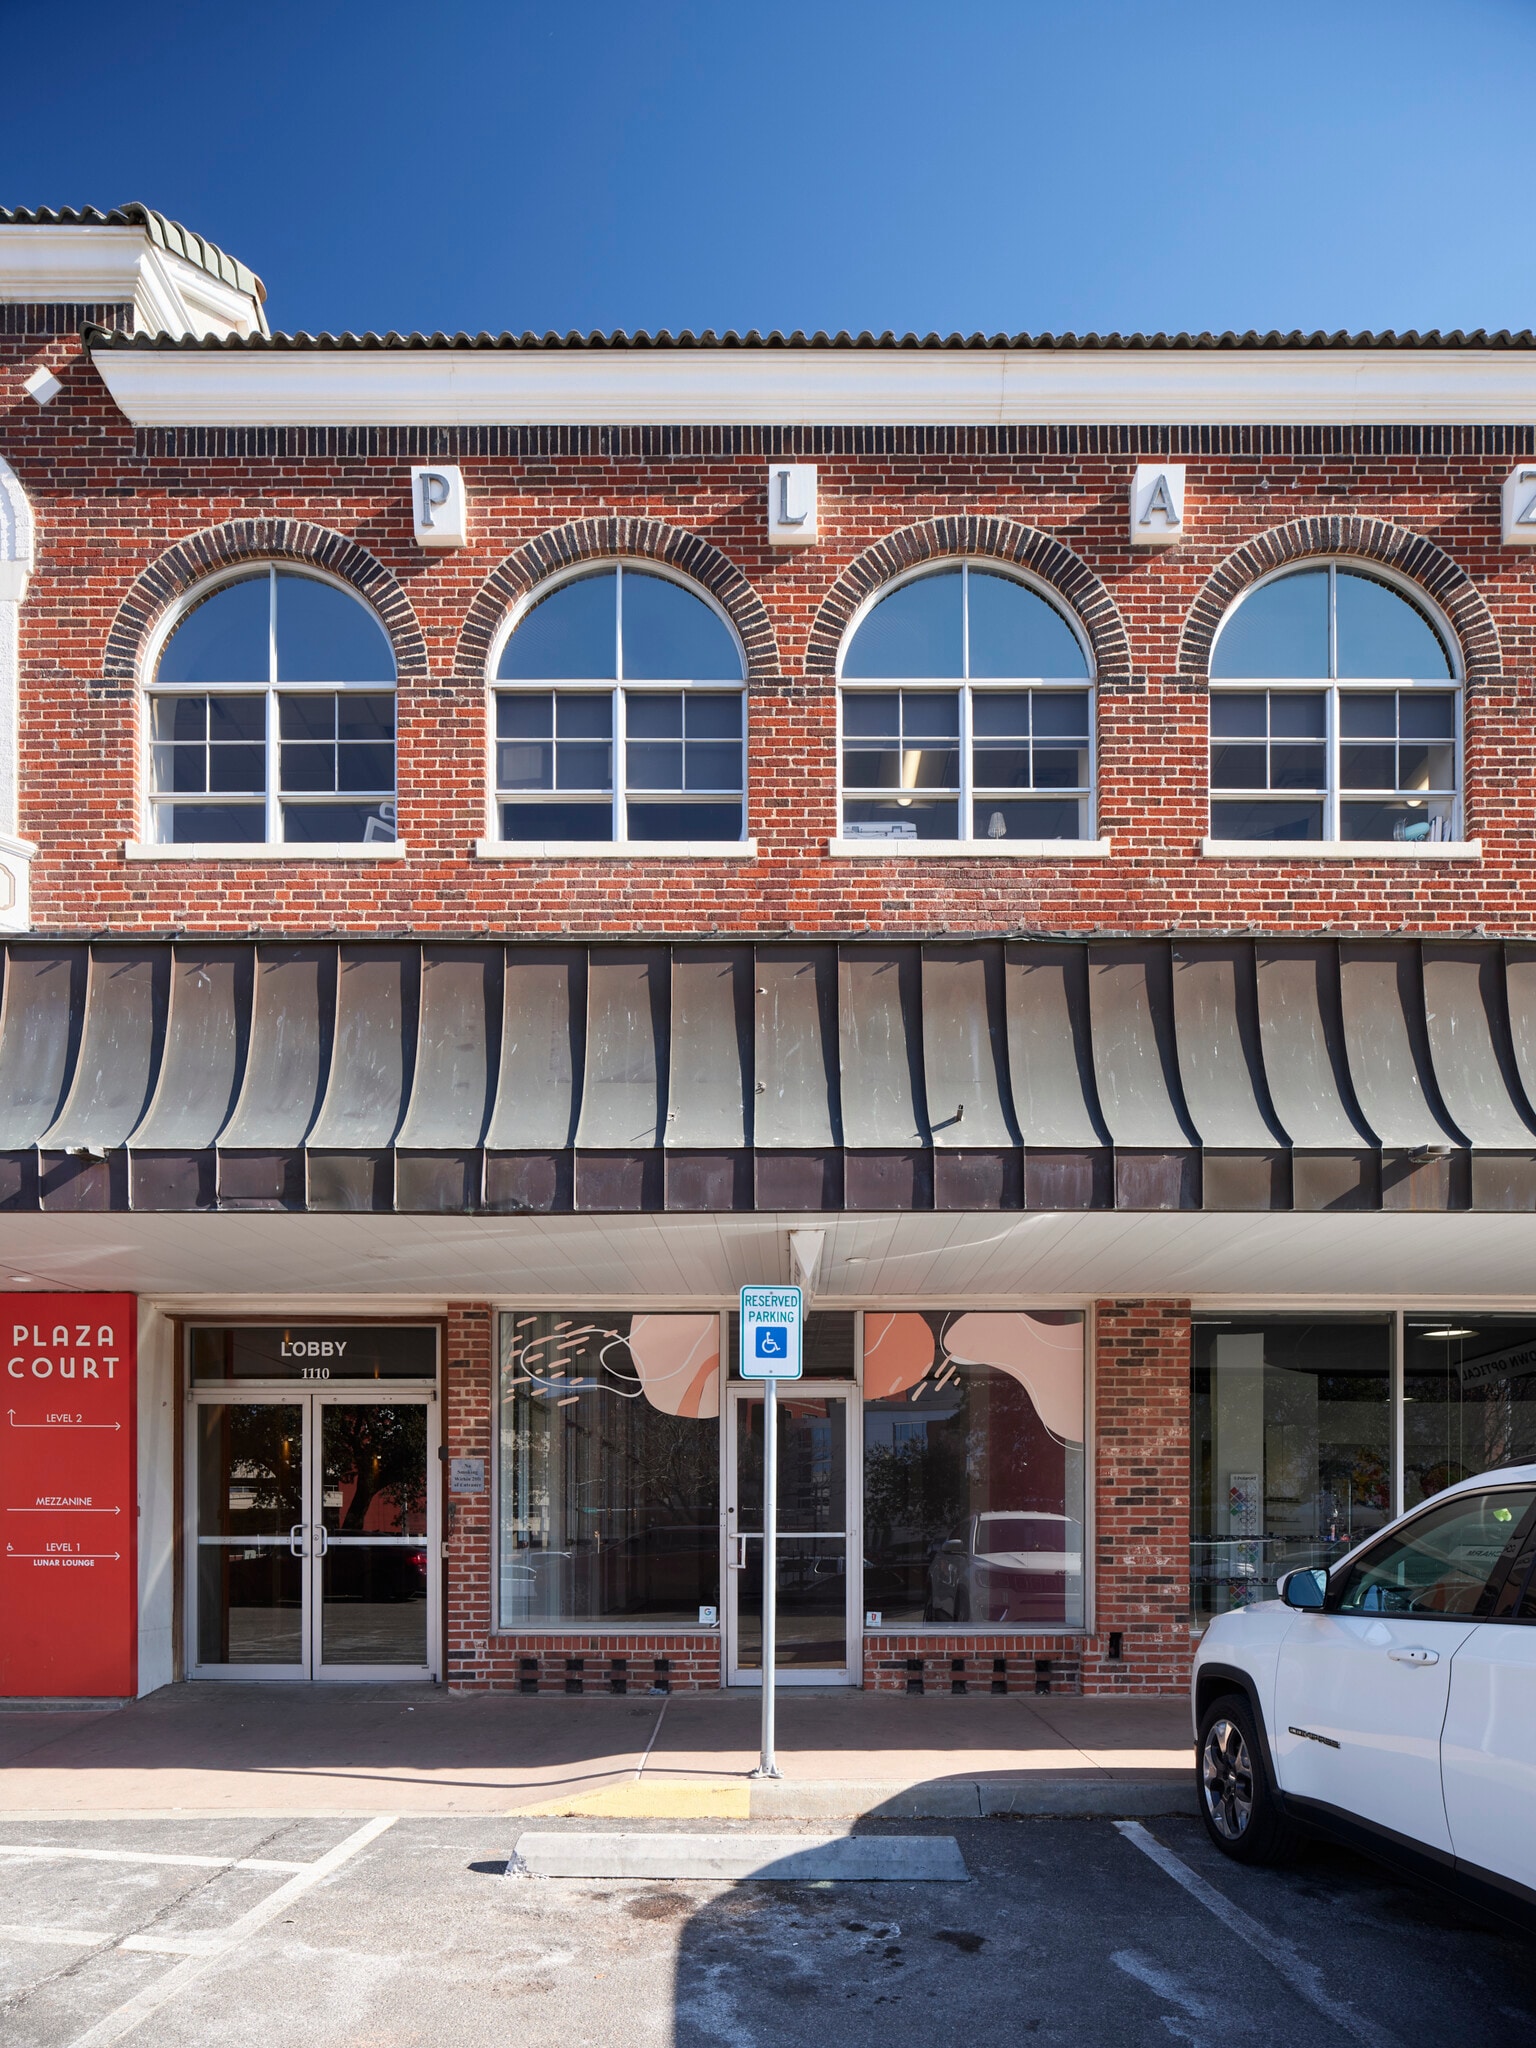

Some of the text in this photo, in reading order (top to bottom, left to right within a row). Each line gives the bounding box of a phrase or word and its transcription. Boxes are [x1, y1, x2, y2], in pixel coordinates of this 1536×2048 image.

[745, 1295, 798, 1307] RESERVED
[748, 1311, 795, 1323] PARKING
[13, 1325, 114, 1346] PLAZA
[281, 1341, 347, 1357] LOBBY
[7, 1357, 120, 1379] COURT
[301, 1367, 330, 1379] 1110
[46, 1413, 83, 1423] LEVEL 2
[35, 1497, 92, 1506] MEZZANINE
[46, 1543, 81, 1552] LEVEL 1
[33, 1559, 95, 1567] LUNAR LOUNGE
